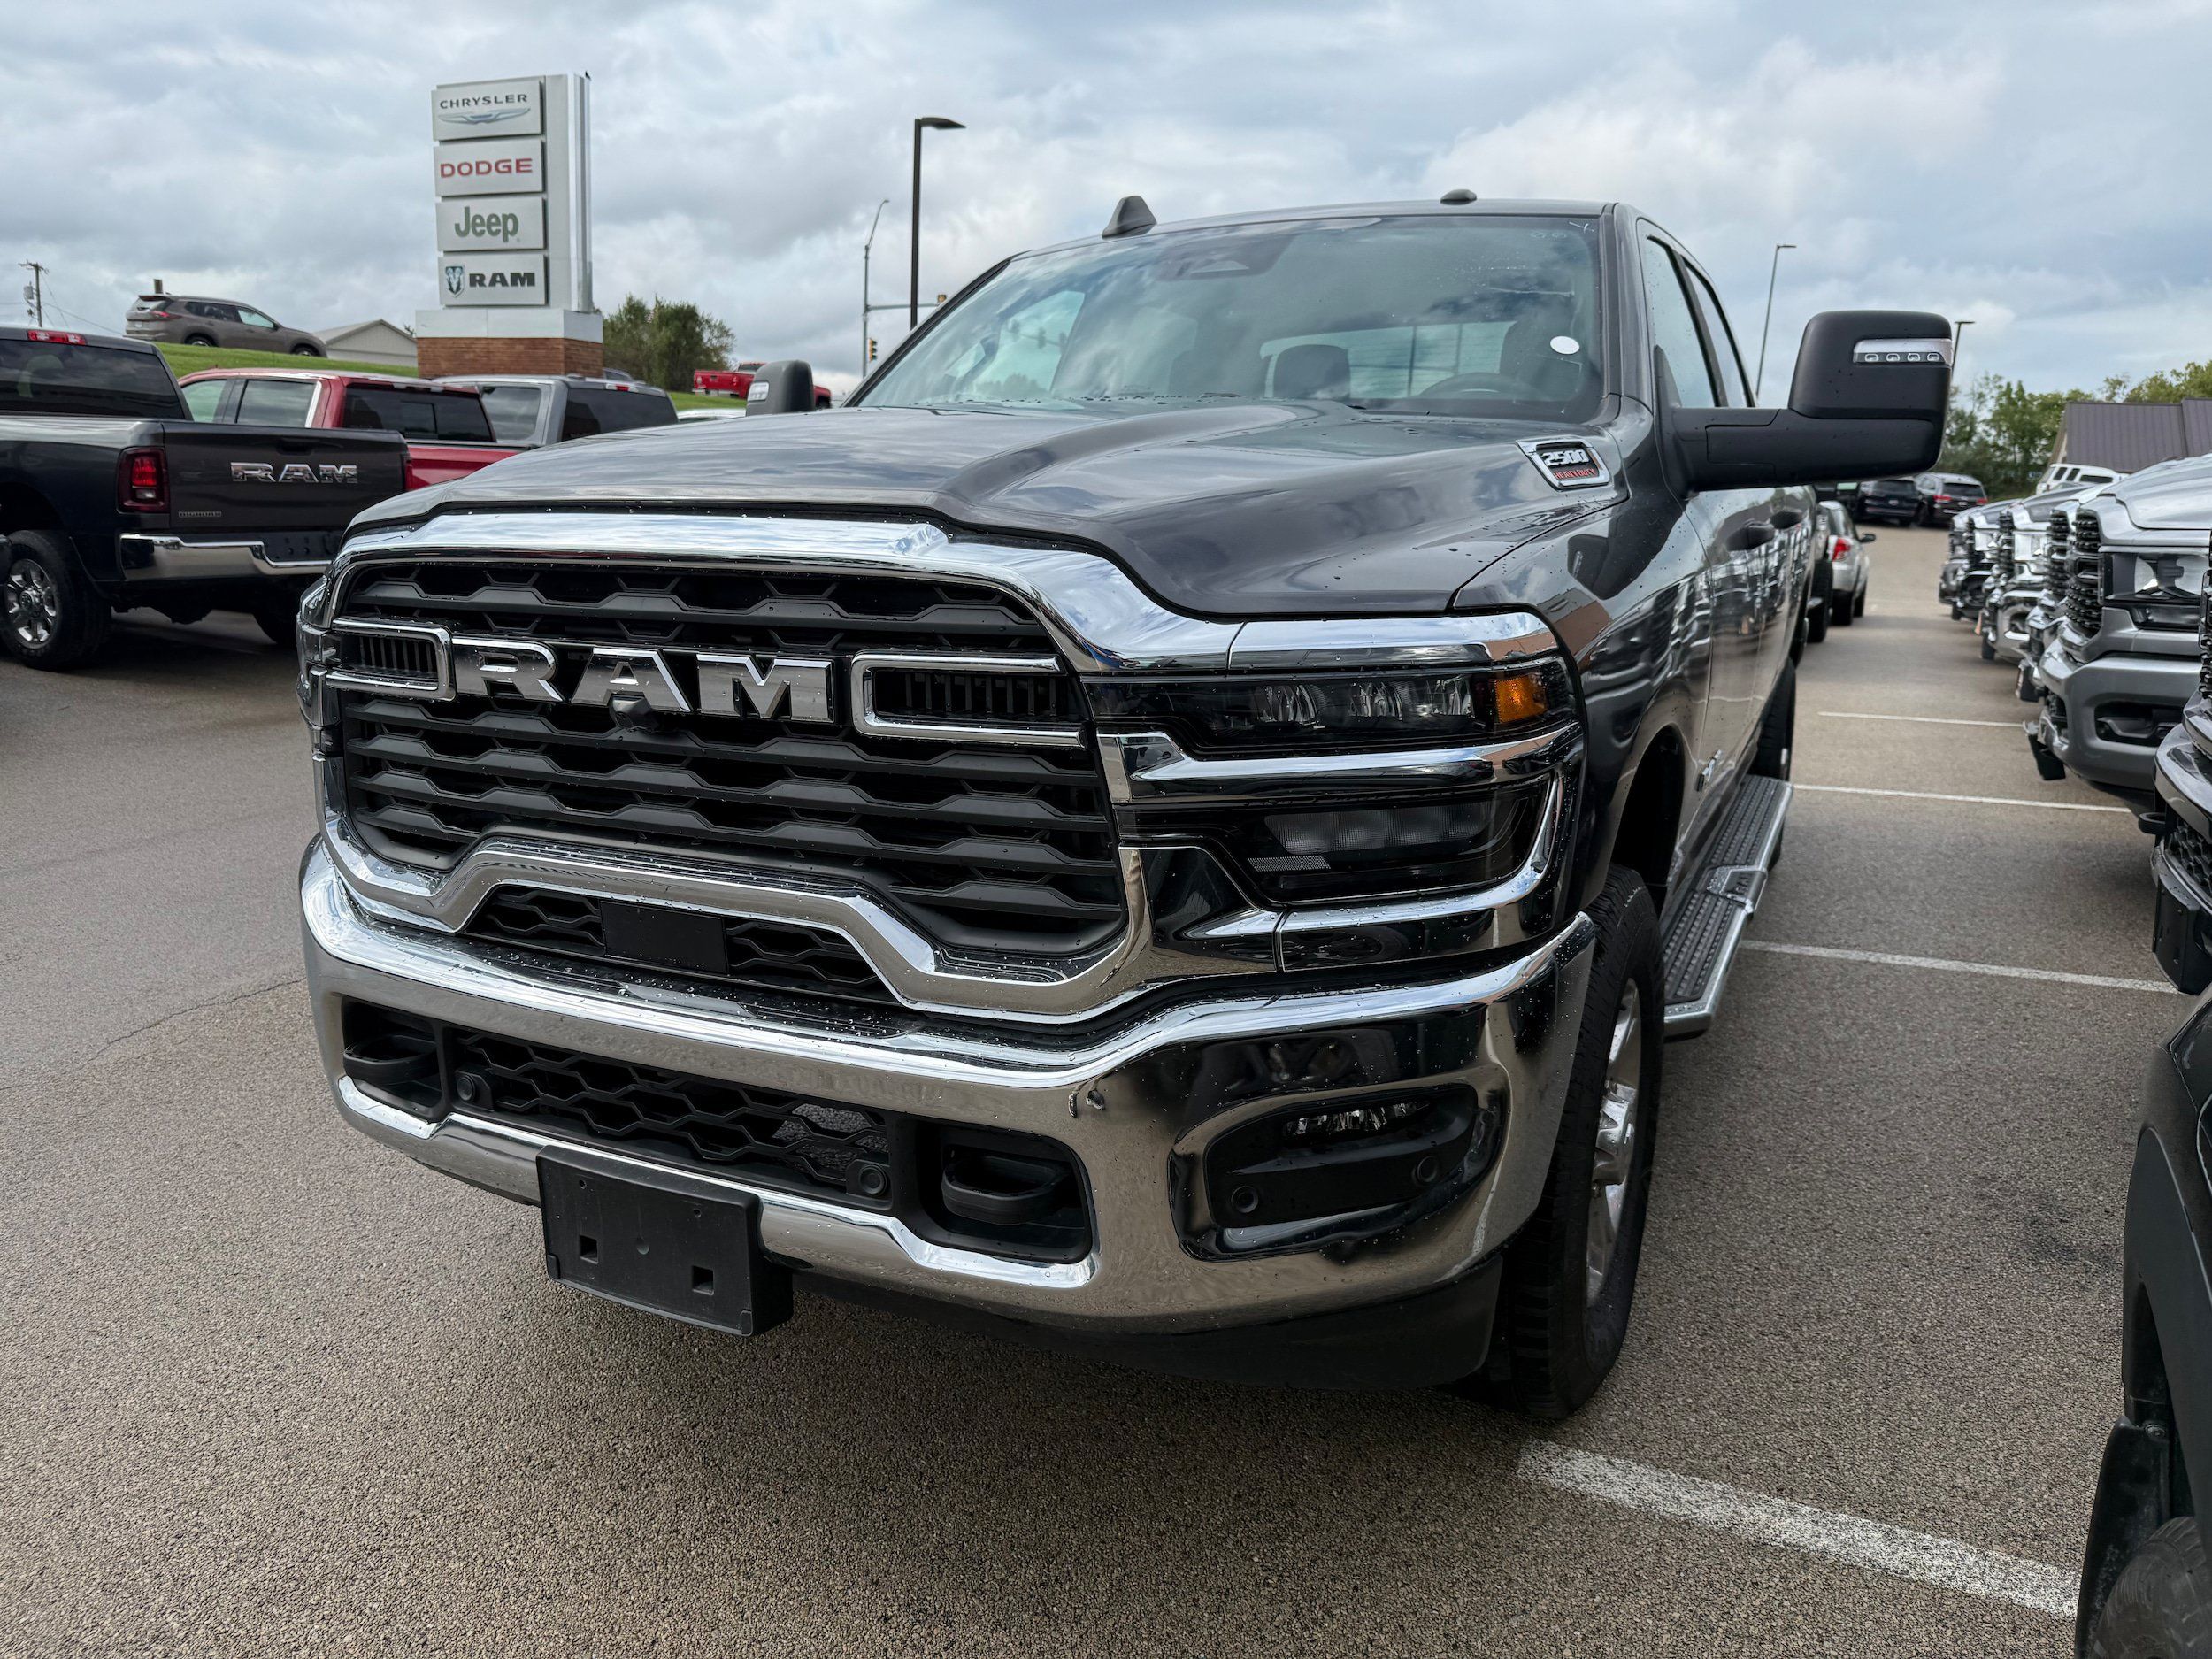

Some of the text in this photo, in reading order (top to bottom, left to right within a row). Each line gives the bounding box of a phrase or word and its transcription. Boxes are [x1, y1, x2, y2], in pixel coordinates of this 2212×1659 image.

[440, 94, 528, 109] CHRYSLER
[440, 158, 533, 178] DODGE
[454, 206, 519, 242] Jeep
[469, 273, 535, 287] RAM
[1540, 449, 1590, 467] 2500
[230, 462, 358, 483] RAM
[1553, 468, 1597, 479] HEAVY DUTY
[452, 638, 835, 723] RAM
